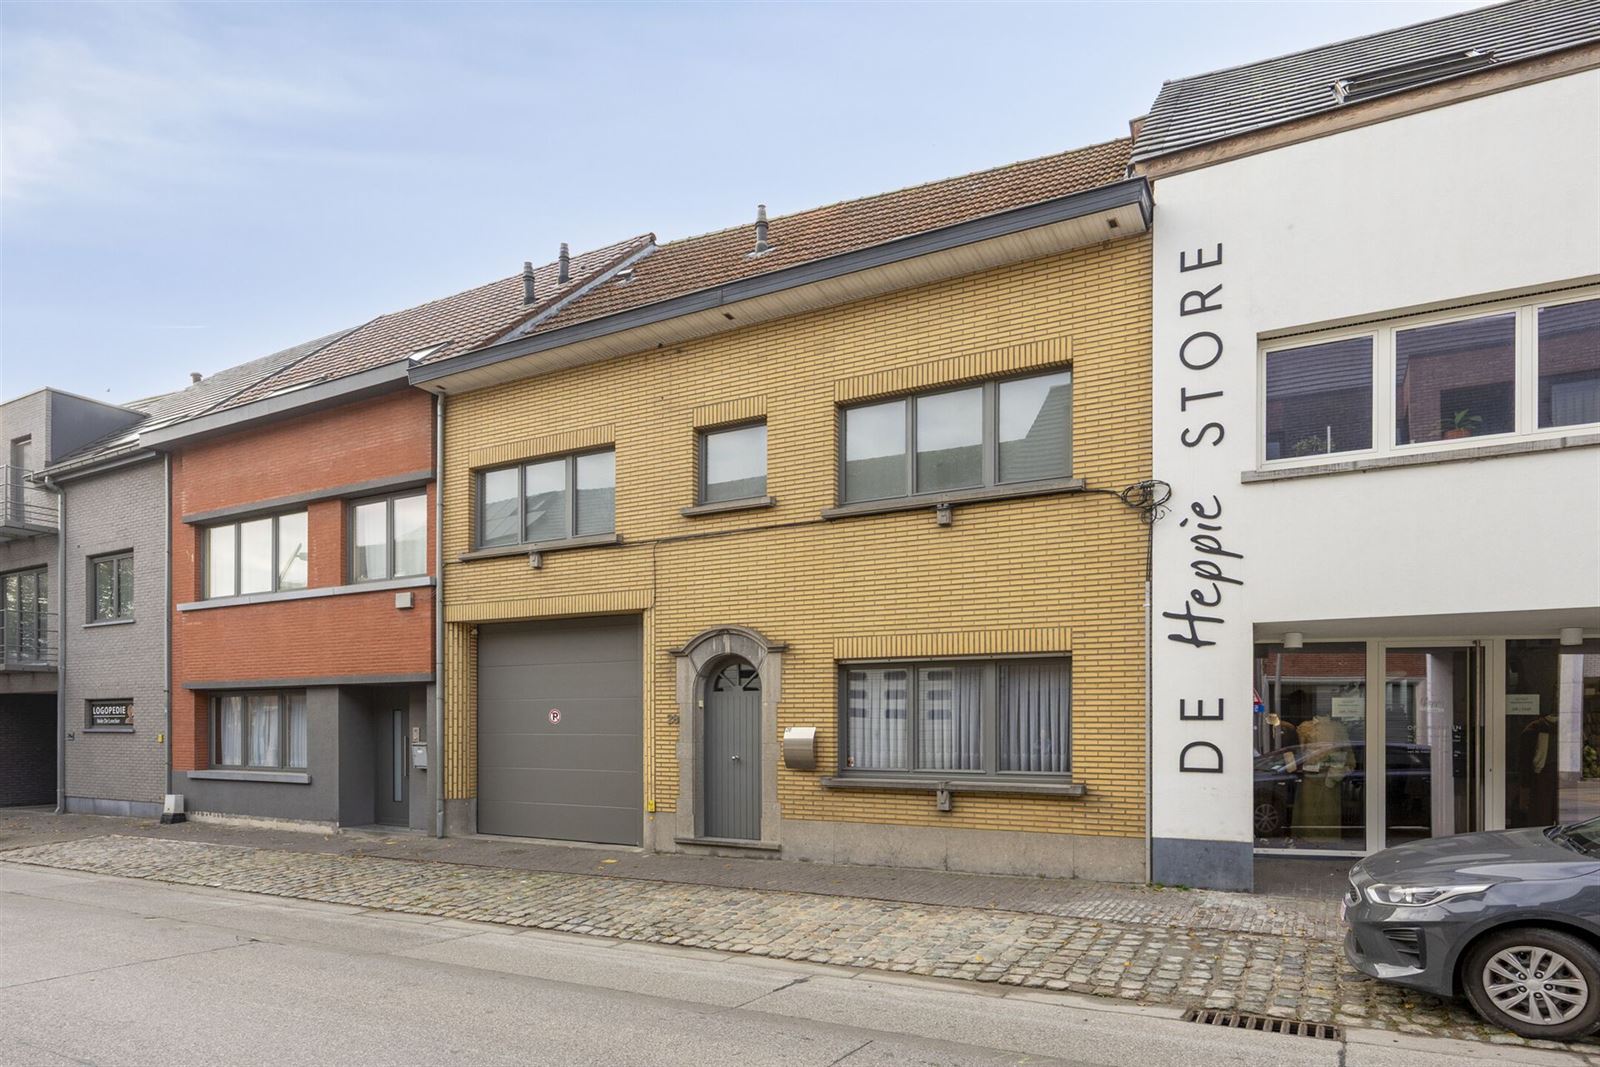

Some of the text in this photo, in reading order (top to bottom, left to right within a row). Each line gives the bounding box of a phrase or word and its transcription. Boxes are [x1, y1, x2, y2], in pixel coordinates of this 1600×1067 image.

[1162, 242, 1244, 773] DE Heppie STORE
[92, 706, 126, 715] LOGOPEDIE
